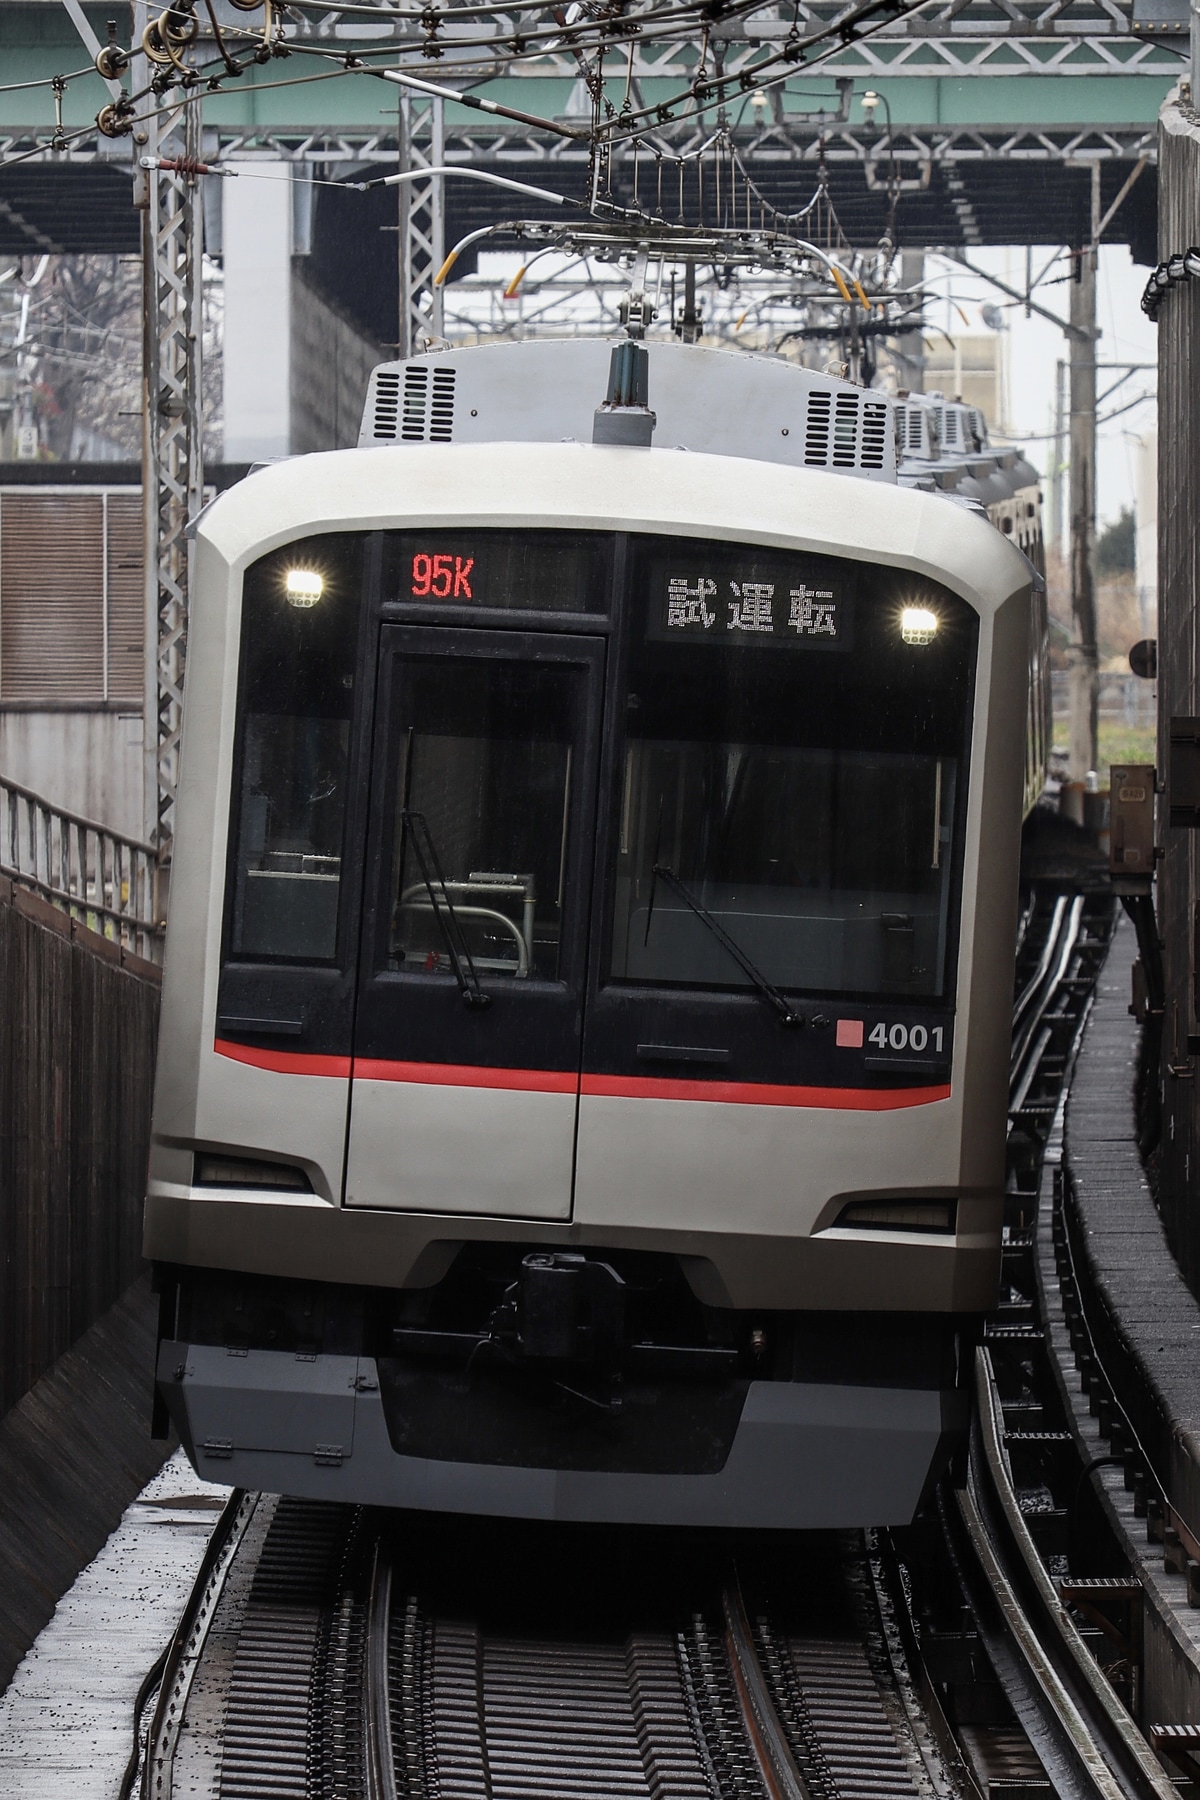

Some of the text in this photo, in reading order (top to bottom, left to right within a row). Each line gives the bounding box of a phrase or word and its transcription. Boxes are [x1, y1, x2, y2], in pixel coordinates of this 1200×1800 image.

[411, 553, 474, 599] 95K
[667, 577, 837, 636] 試運転
[868, 1022, 944, 1052] 4001
